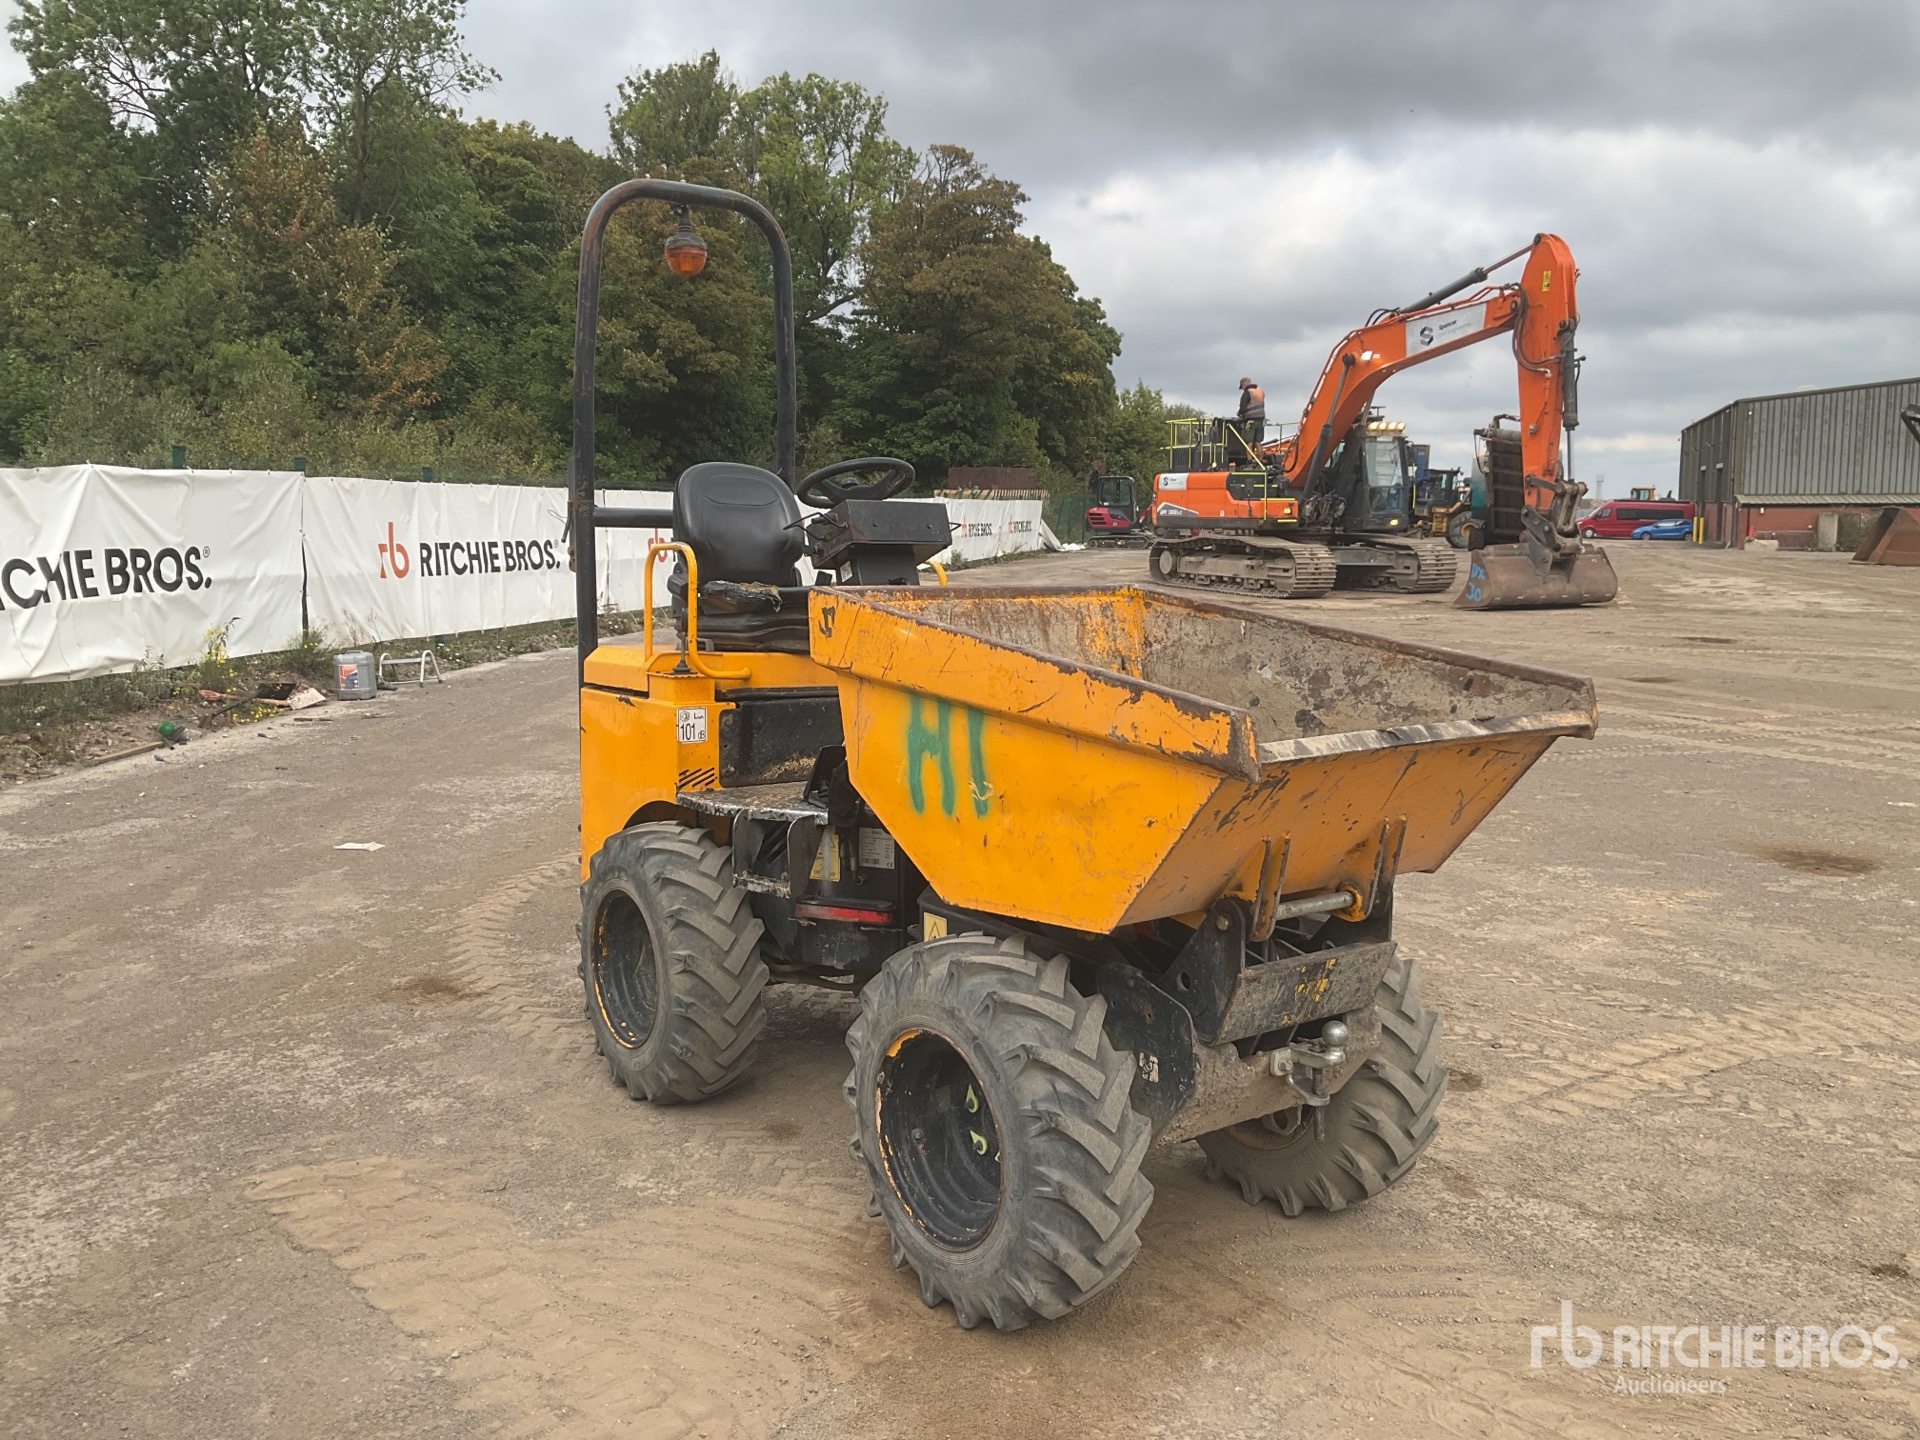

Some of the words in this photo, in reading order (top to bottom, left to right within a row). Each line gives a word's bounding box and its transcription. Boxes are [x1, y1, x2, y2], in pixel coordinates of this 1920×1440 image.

[419, 541, 501, 577] RITCHIE
[503, 539, 561, 572] BROS.
[0, 549, 100, 611] CHIE
[104, 546, 212, 595] BROS.
[680, 723, 696, 741] 101
